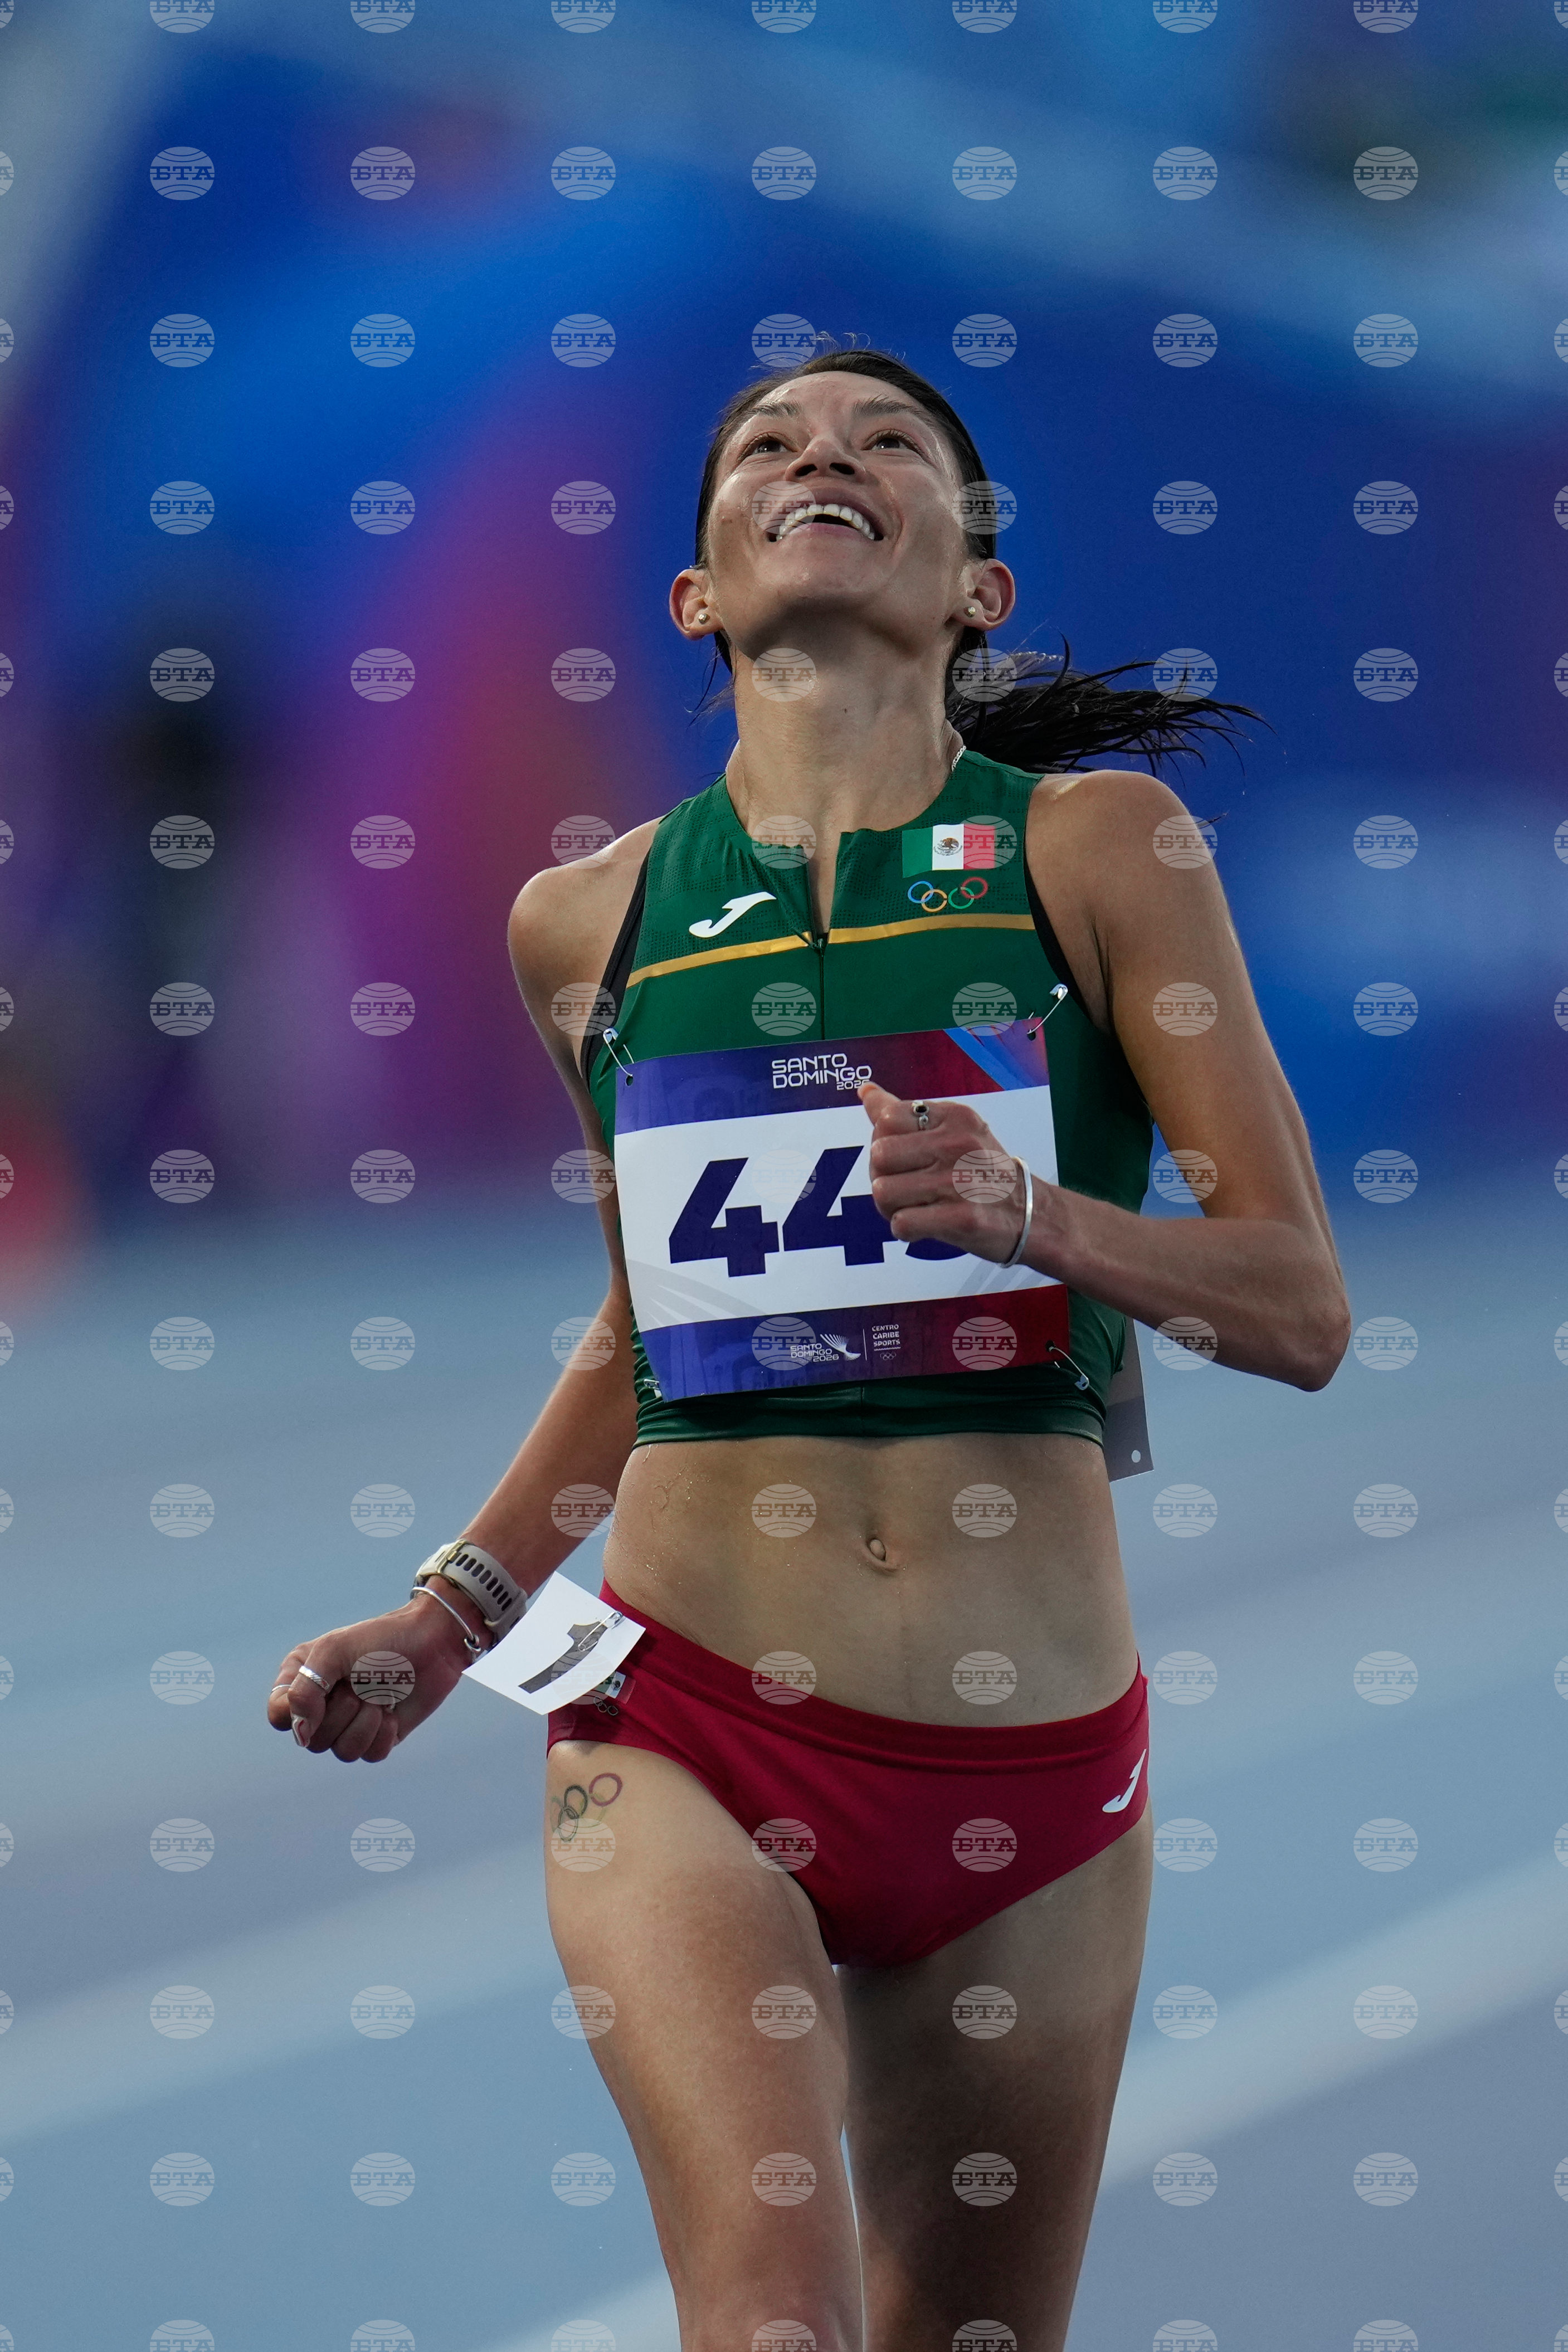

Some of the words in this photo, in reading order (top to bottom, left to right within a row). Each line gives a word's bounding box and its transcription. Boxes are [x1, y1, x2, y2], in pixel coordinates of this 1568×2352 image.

[772, 1053, 848, 1074] SANTO
[772, 1065, 872, 1089] DOMINGO
[836, 1079, 870, 1090] 202
[669, 1145, 971, 1277] 44
[873, 1331, 900, 1340] CARIBE
[790, 1343, 822, 1352] SANTO
[791, 1348, 832, 1358] DOMINGO
[518, 1621, 608, 1694] 1
